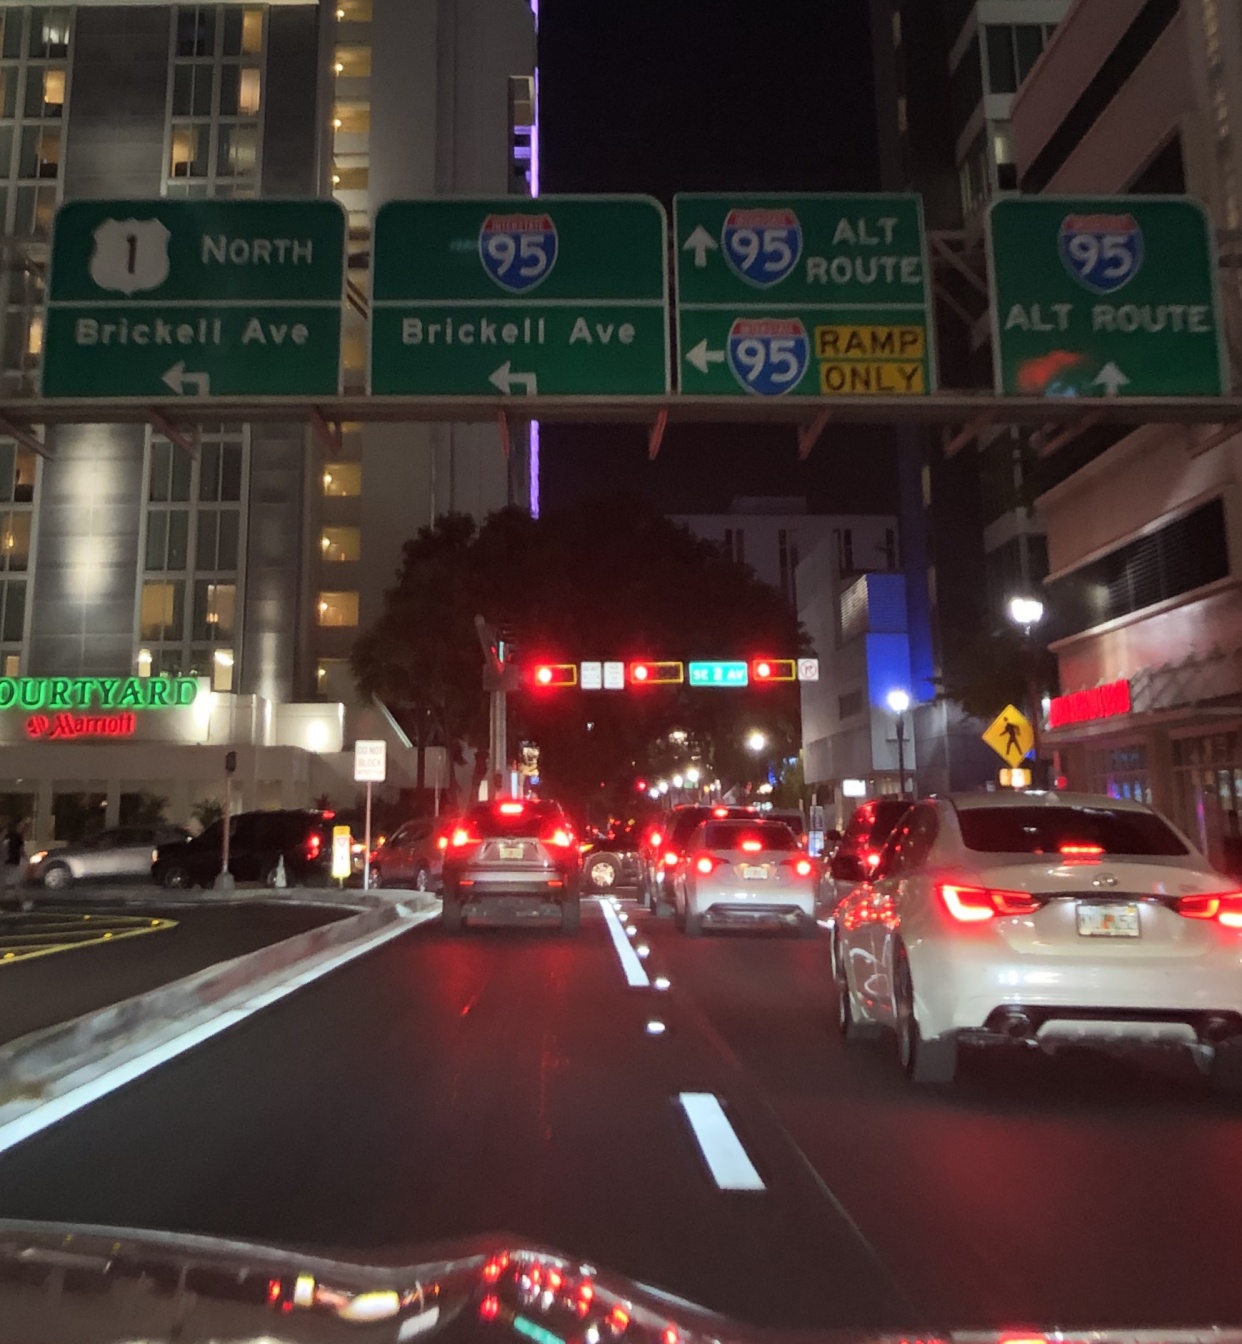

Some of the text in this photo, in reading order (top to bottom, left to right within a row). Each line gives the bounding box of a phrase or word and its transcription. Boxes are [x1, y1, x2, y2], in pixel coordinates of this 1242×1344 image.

[832, 217, 898, 245] ALT
[126, 234, 138, 275] 1
[202, 234, 313, 265] NORTH
[488, 234, 547, 276] 95
[731, 228, 791, 272] 95
[1069, 235, 1133, 277] 95
[806, 256, 923, 284] ROUTE
[75, 316, 309, 345] Brickell Ave
[402, 316, 636, 344] Brickell Ave
[1004, 303, 1211, 333] ALT ROUTE
[820, 330, 919, 355] RAMP
[737, 339, 799, 383] 95
[825, 365, 919, 391] ONLY
[0, 677, 199, 709] OURTYARD
[50, 713, 136, 738] Marriott
